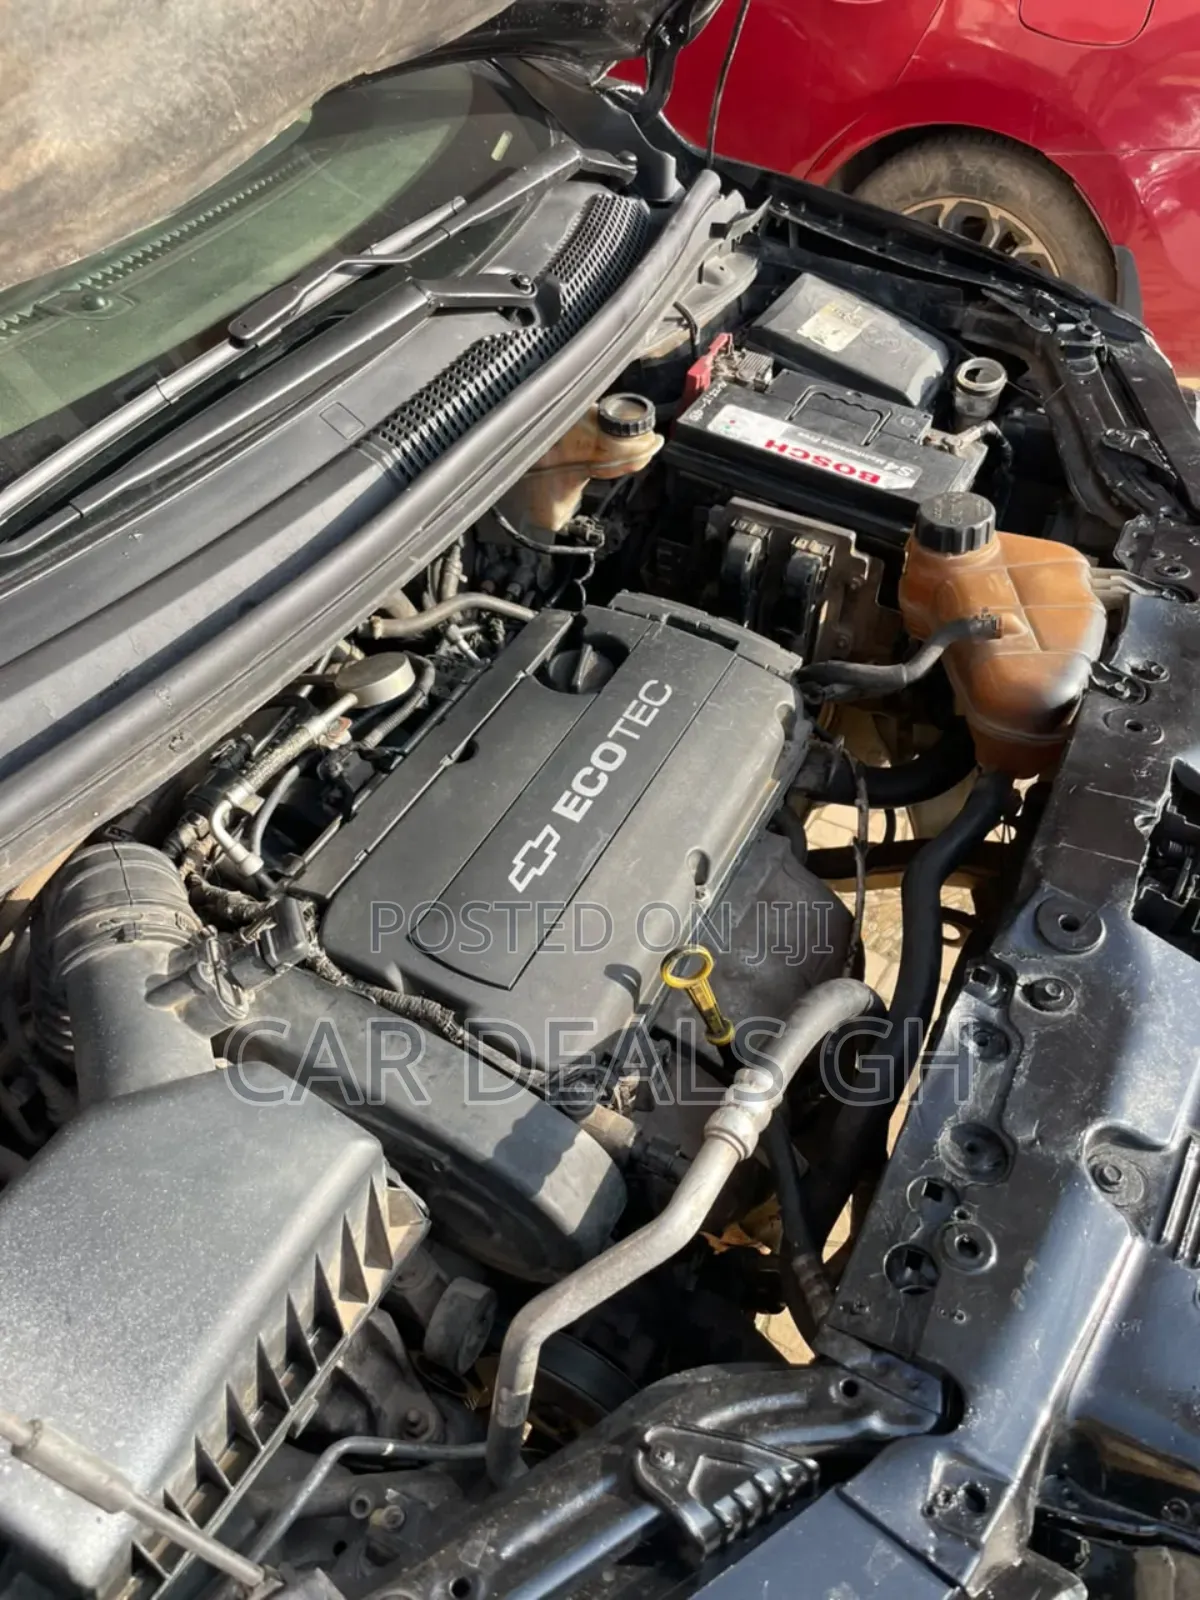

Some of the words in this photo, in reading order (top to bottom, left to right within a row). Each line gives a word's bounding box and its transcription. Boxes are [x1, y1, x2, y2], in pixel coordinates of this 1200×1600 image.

[764, 439, 881, 484] BOSCH
[884, 461, 915, 478] S4
[551, 679, 673, 822] ECOTEC
